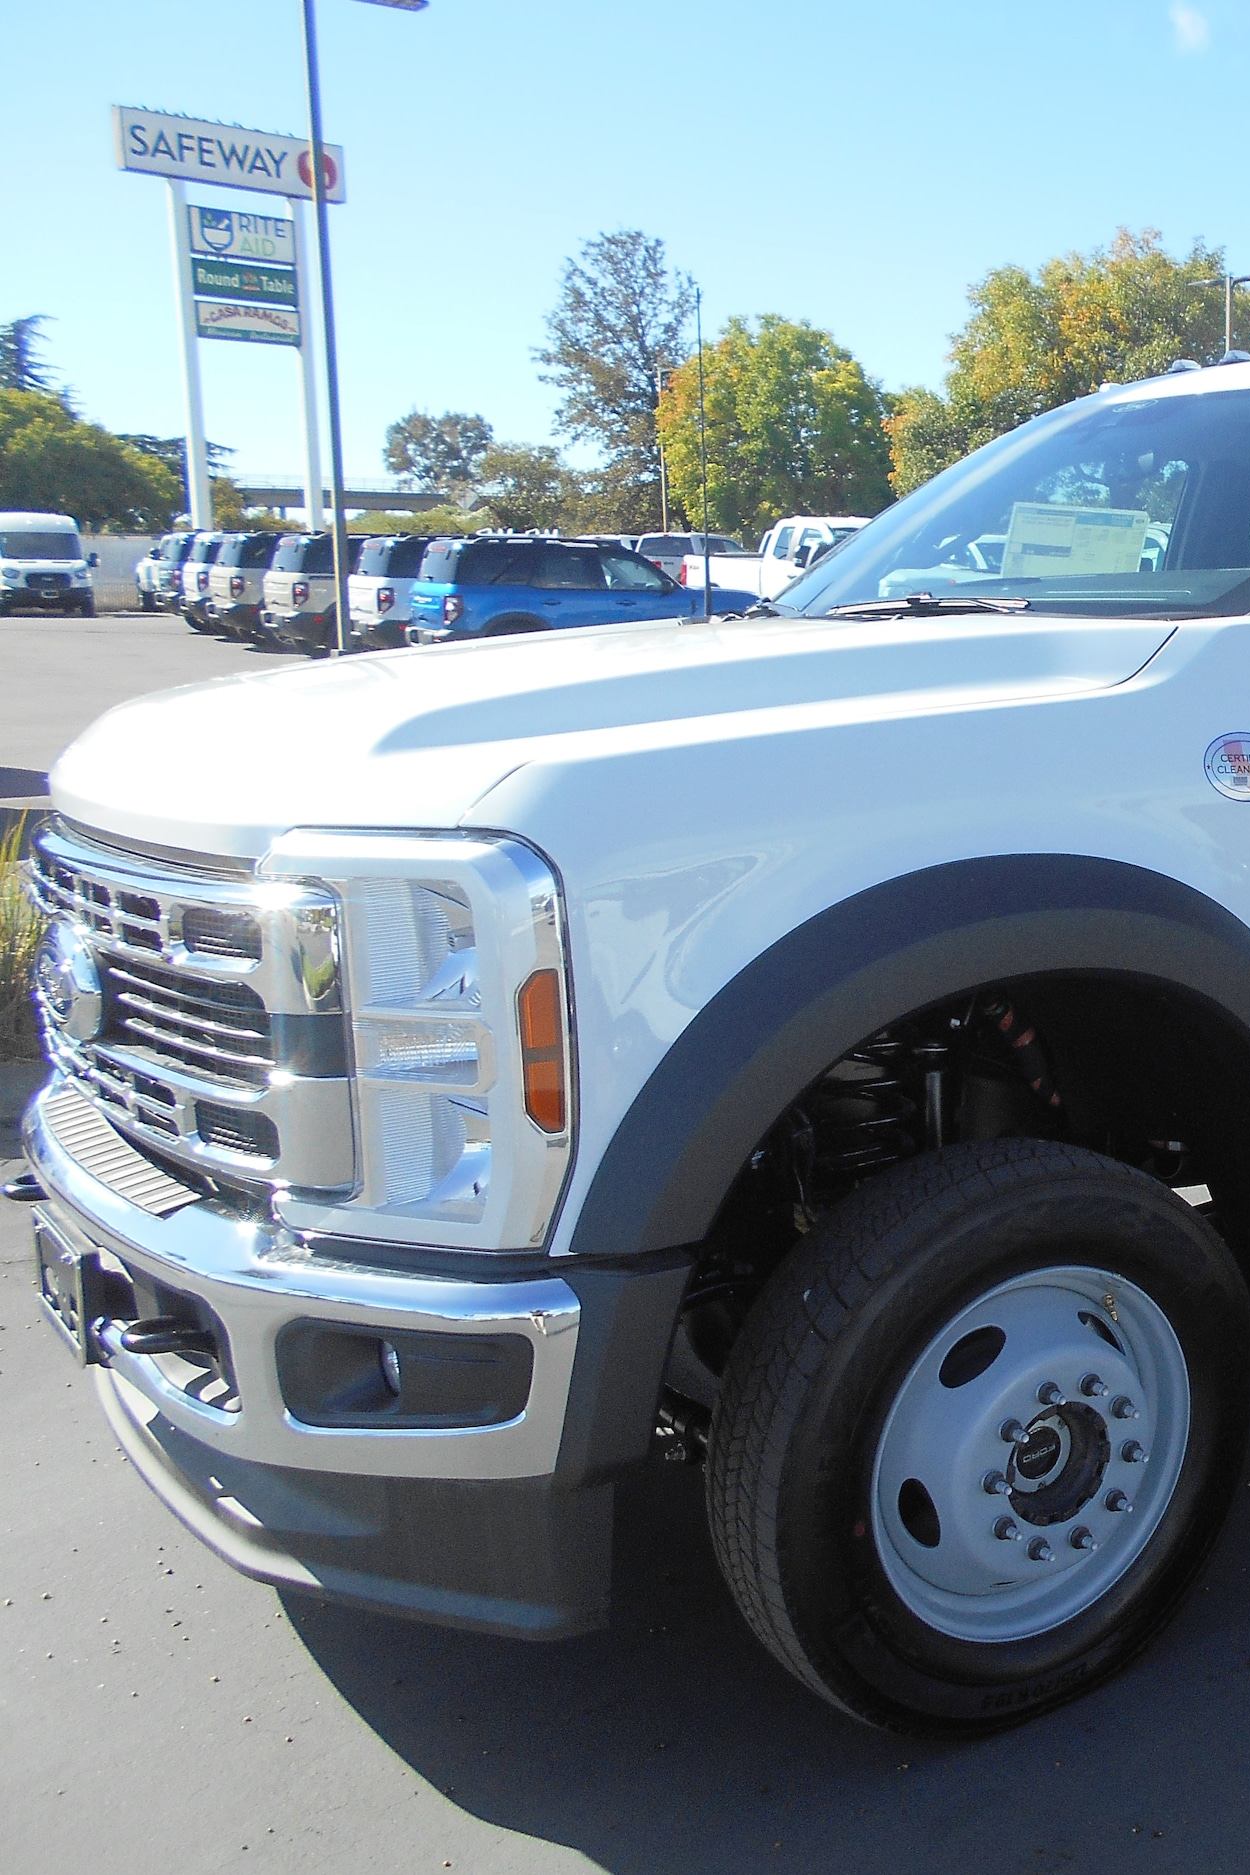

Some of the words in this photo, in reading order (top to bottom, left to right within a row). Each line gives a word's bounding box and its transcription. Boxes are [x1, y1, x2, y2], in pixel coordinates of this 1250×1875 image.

[130, 125, 288, 178] SAFEWAY
[240, 213, 286, 239] RITE
[240, 236, 275, 257] AID
[197, 267, 240, 288] Round
[260, 275, 294, 294] Table
[210, 306, 242, 323] CASA
[244, 307, 288, 330] RAMOS
[1217, 765, 1250, 774] CLEAN
[1023, 1444, 1056, 1463] FORD
